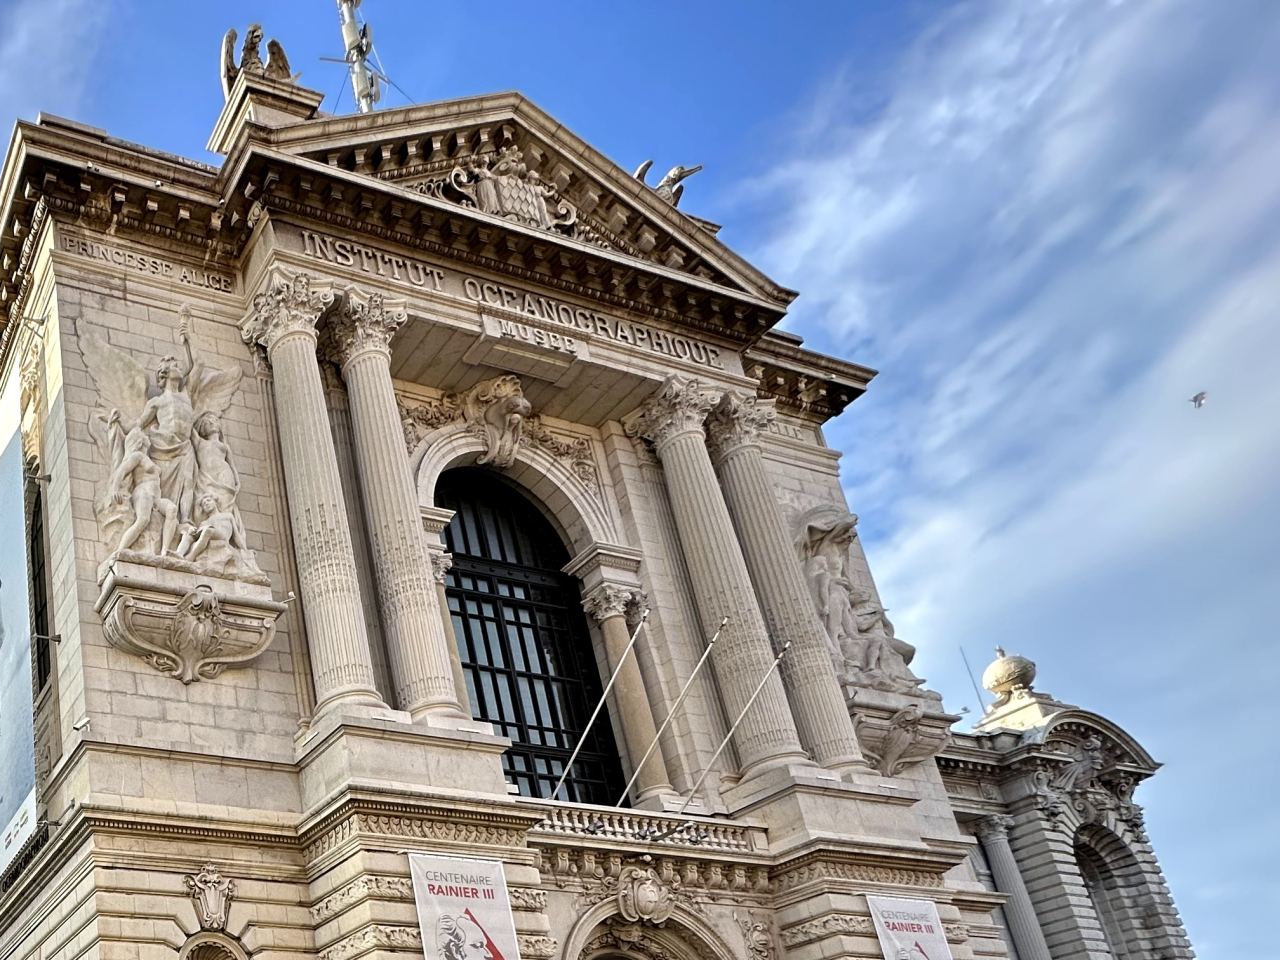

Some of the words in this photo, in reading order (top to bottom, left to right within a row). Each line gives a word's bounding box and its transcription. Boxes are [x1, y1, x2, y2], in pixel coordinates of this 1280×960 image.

[64, 238, 174, 277] PRINCESSE
[179, 267, 232, 292] ALICE
[302, 231, 444, 291] INSTITUT
[464, 278, 725, 369] OCEANOGRAPHIQUE
[499, 319, 577, 353] MUSEE
[425, 870, 493, 886] CENTENAIRE
[427, 884, 479, 899] RAINIER
[482, 889, 495, 899] III
[881, 910, 931, 922] CENTENAIRE
[883, 922, 924, 933] RAINIER
[924, 924, 935, 934] III
